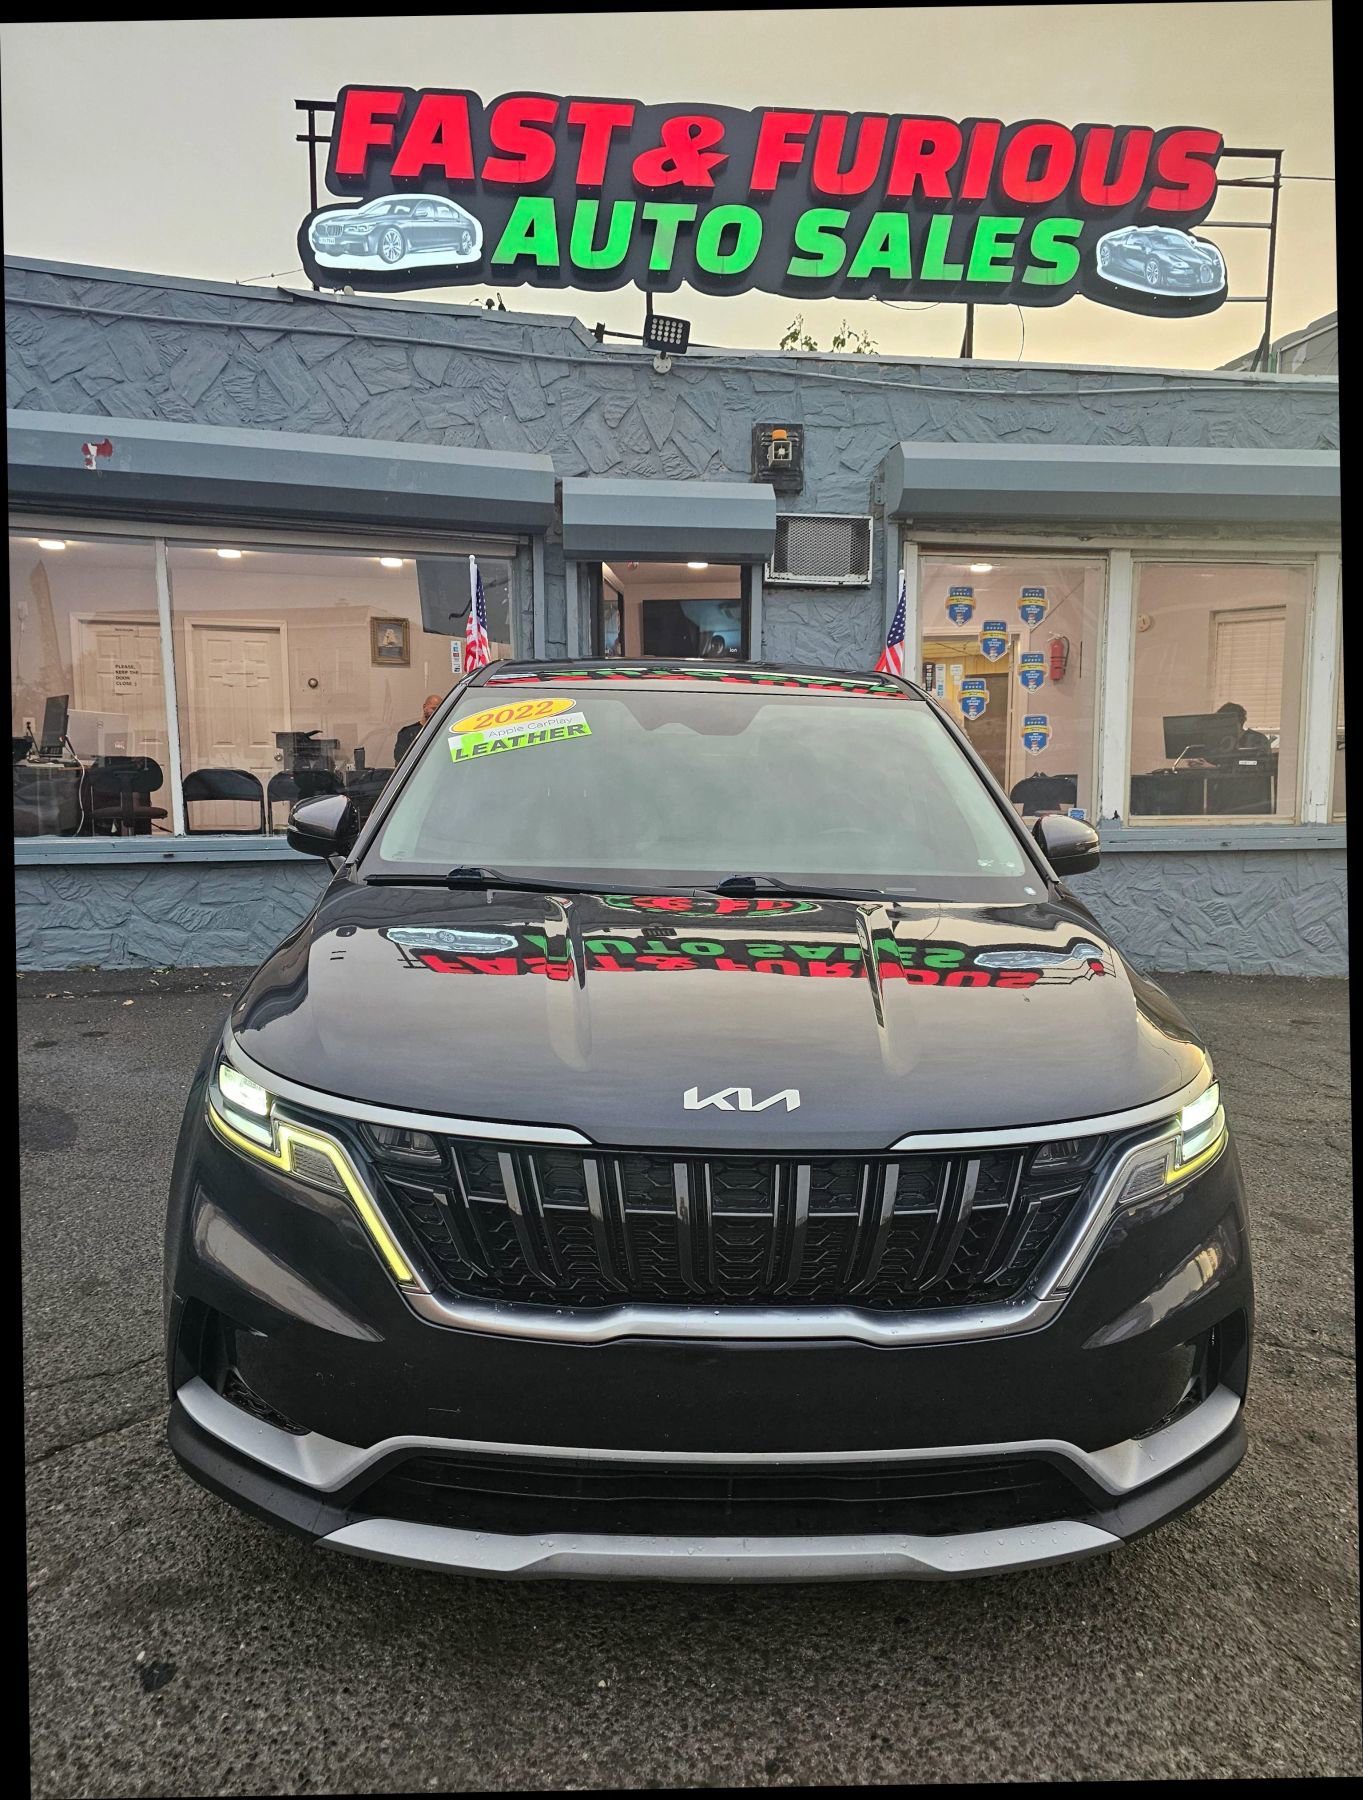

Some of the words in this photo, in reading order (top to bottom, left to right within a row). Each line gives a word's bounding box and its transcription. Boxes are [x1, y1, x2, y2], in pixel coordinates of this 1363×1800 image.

[335, 90, 636, 186] FAST
[632, 115, 730, 188] &
[750, 111, 1223, 213] FURIOUS
[490, 196, 763, 275] AUTO
[787, 208, 1085, 286] SALES
[473, 700, 554, 730] 2022
[488, 724, 525, 738] Apple
[527, 717, 574, 731] CarPlay
[455, 723, 587, 761] LEATHER
